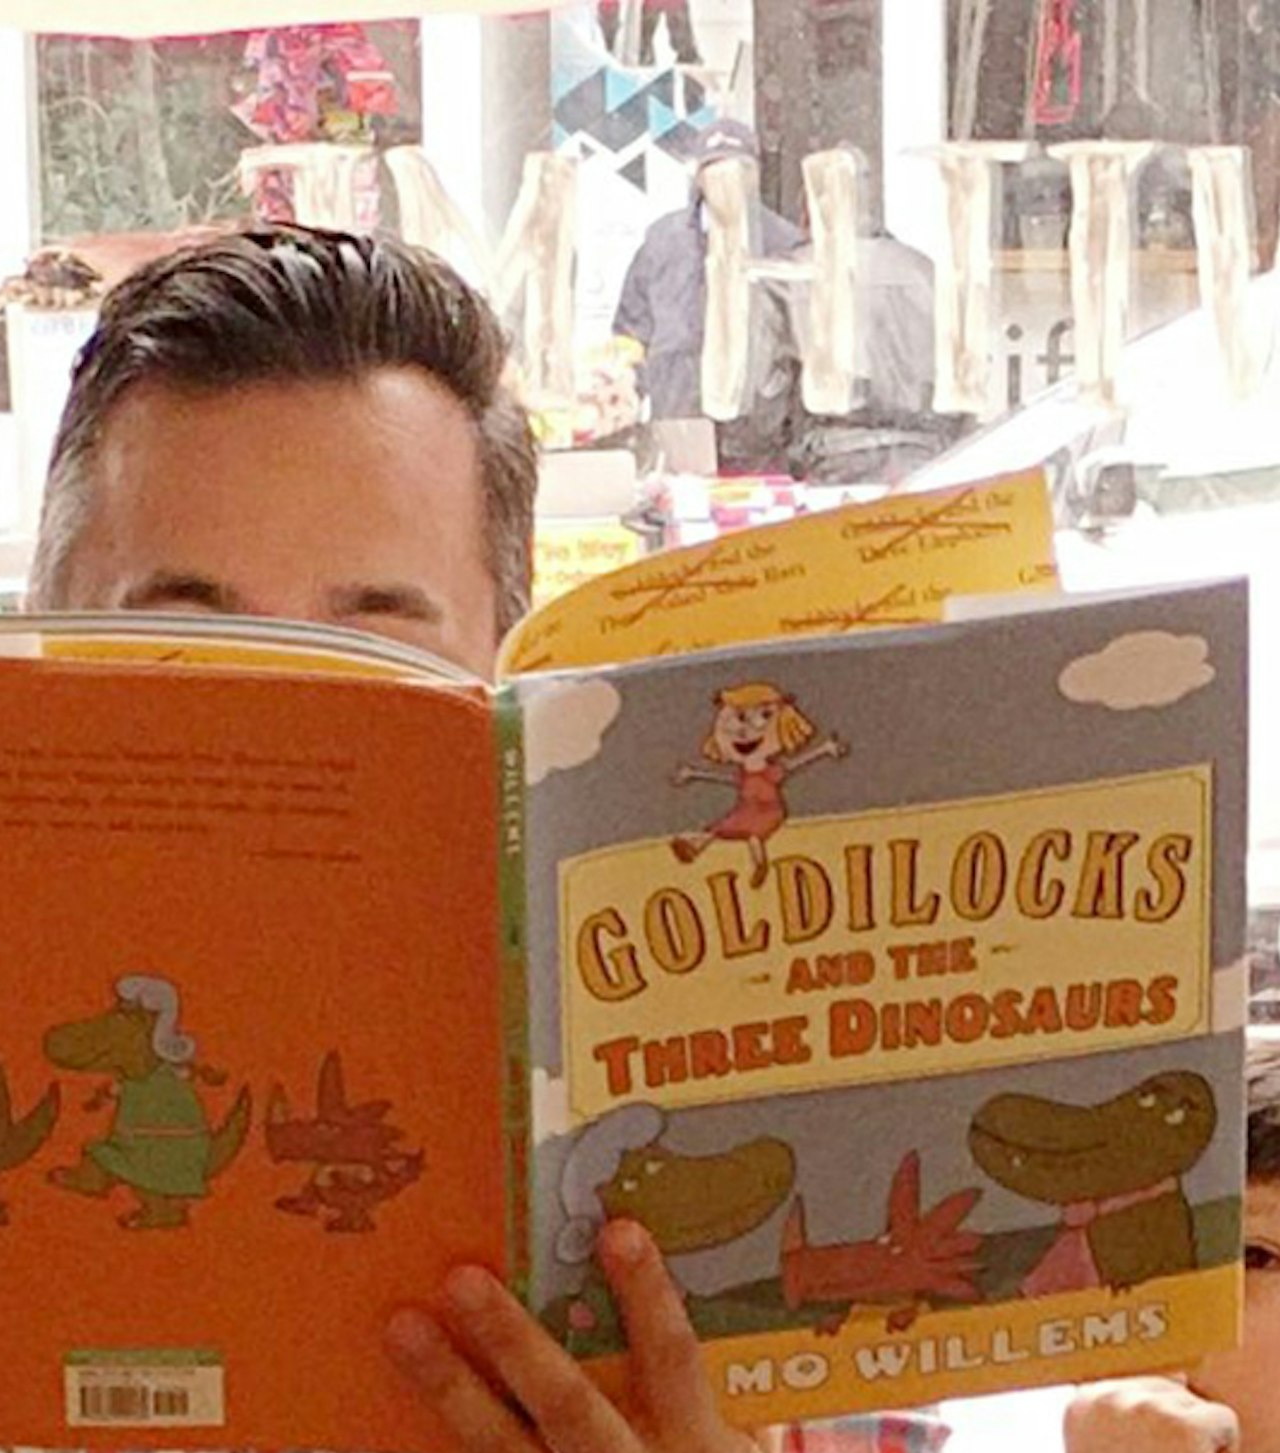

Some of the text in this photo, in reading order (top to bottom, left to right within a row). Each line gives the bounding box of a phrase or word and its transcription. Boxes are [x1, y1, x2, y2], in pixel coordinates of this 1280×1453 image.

[576, 829, 1194, 1003] GOLDILOCKS
[785, 936, 979, 994] AND THE
[592, 974, 1181, 1097] THREE DINOSAURS
[724, 1303, 1170, 1396] MO WILLEMS
